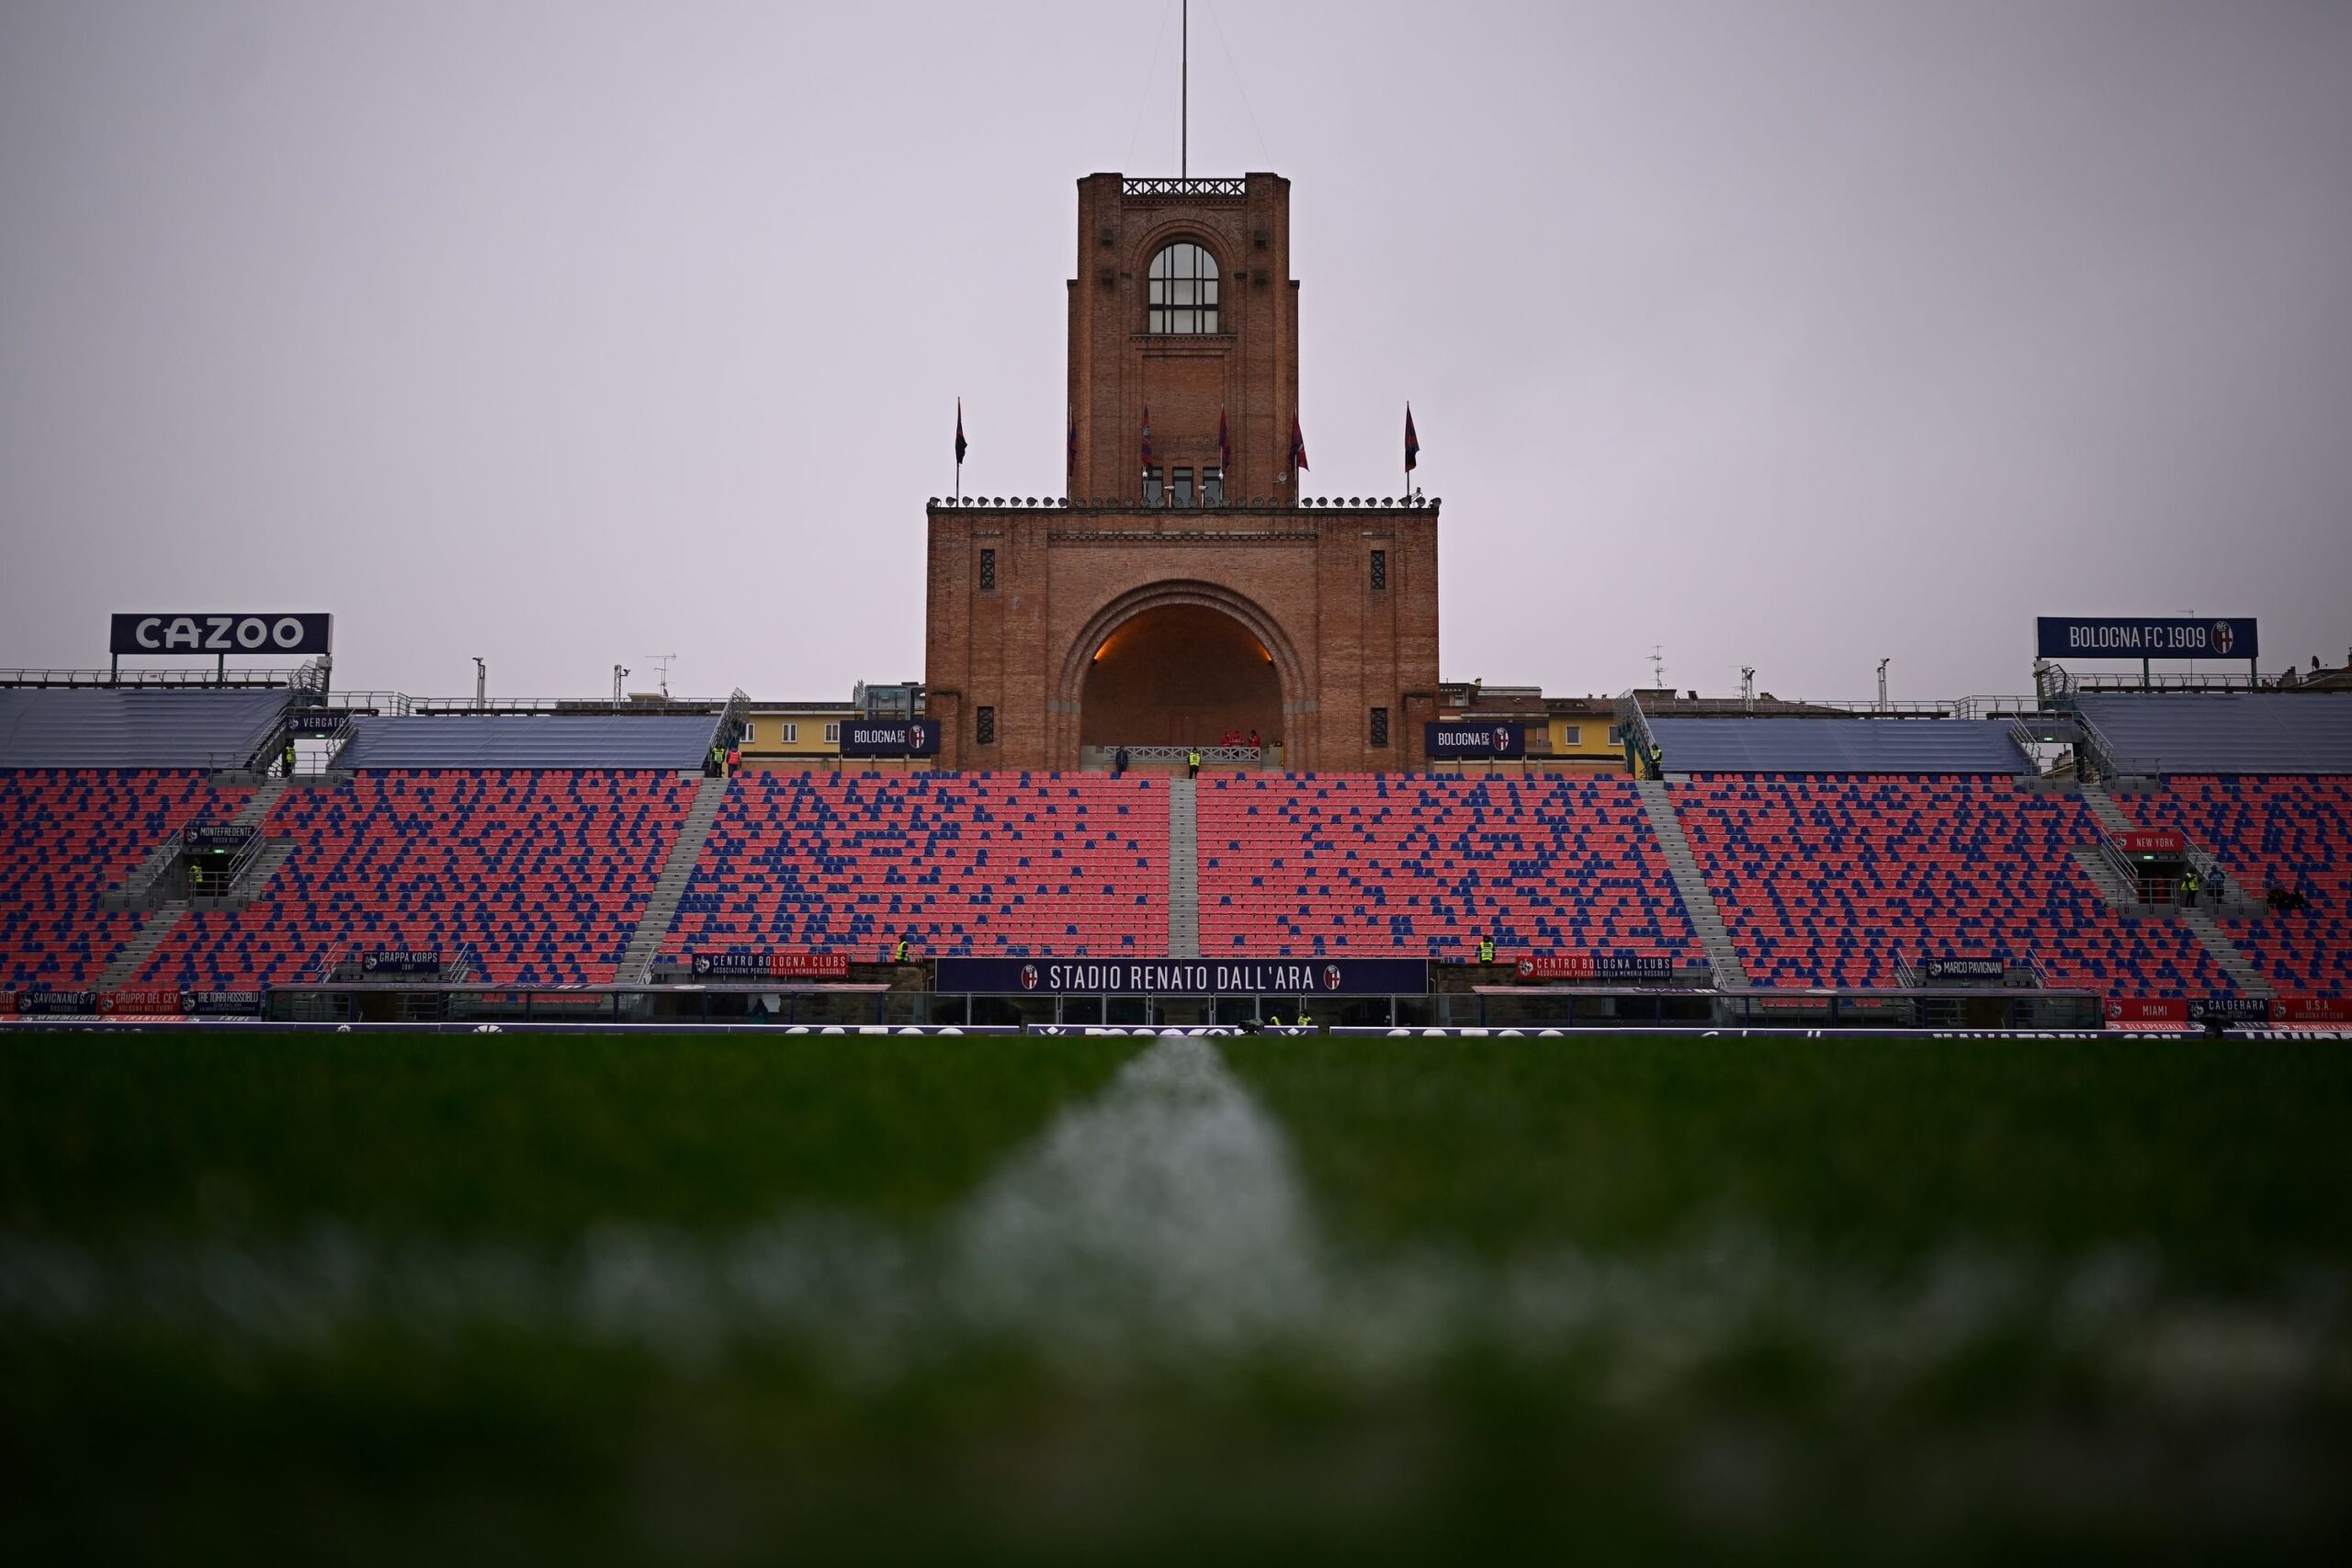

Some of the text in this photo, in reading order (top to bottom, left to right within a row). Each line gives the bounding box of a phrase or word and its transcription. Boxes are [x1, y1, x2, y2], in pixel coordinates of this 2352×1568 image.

[135, 616, 304, 649] CAZOO
[2070, 626, 2206, 649] BOLOGNA FC 1909
[303, 717, 345, 728] VERGATO
[854, 730, 897, 743] BOLOGNA
[898, 730, 905, 739] FC
[1438, 732, 1489, 746] BOLOGNA FC
[199, 827, 253, 837] MONTEFREDENTE
[2136, 838, 2174, 848] NEW YORK
[379, 952, 437, 963] GRAPPA KORPS
[713, 955, 845, 966] CENTRO BOLOGNA CLUBS
[1536, 958, 1670, 969] CENTRO BOLOGNA CLUBS
[1943, 962, 2002, 974] MARCO PAVIGNANI
[1049, 965, 1314, 990] STADIO RENATO DALL'ARA
[33, 993, 77, 1004] SAVIGNANO
[116, 993, 178, 1004] GRUPPO DEL CEV
[198, 992, 209, 1002] TRE
[209, 992, 226, 1002] TORRI
[2209, 1000, 2265, 1010] CALDERARA
[2305, 1000, 2332, 1010] U.S.A.
[2143, 1006, 2167, 1016] MIAMI
